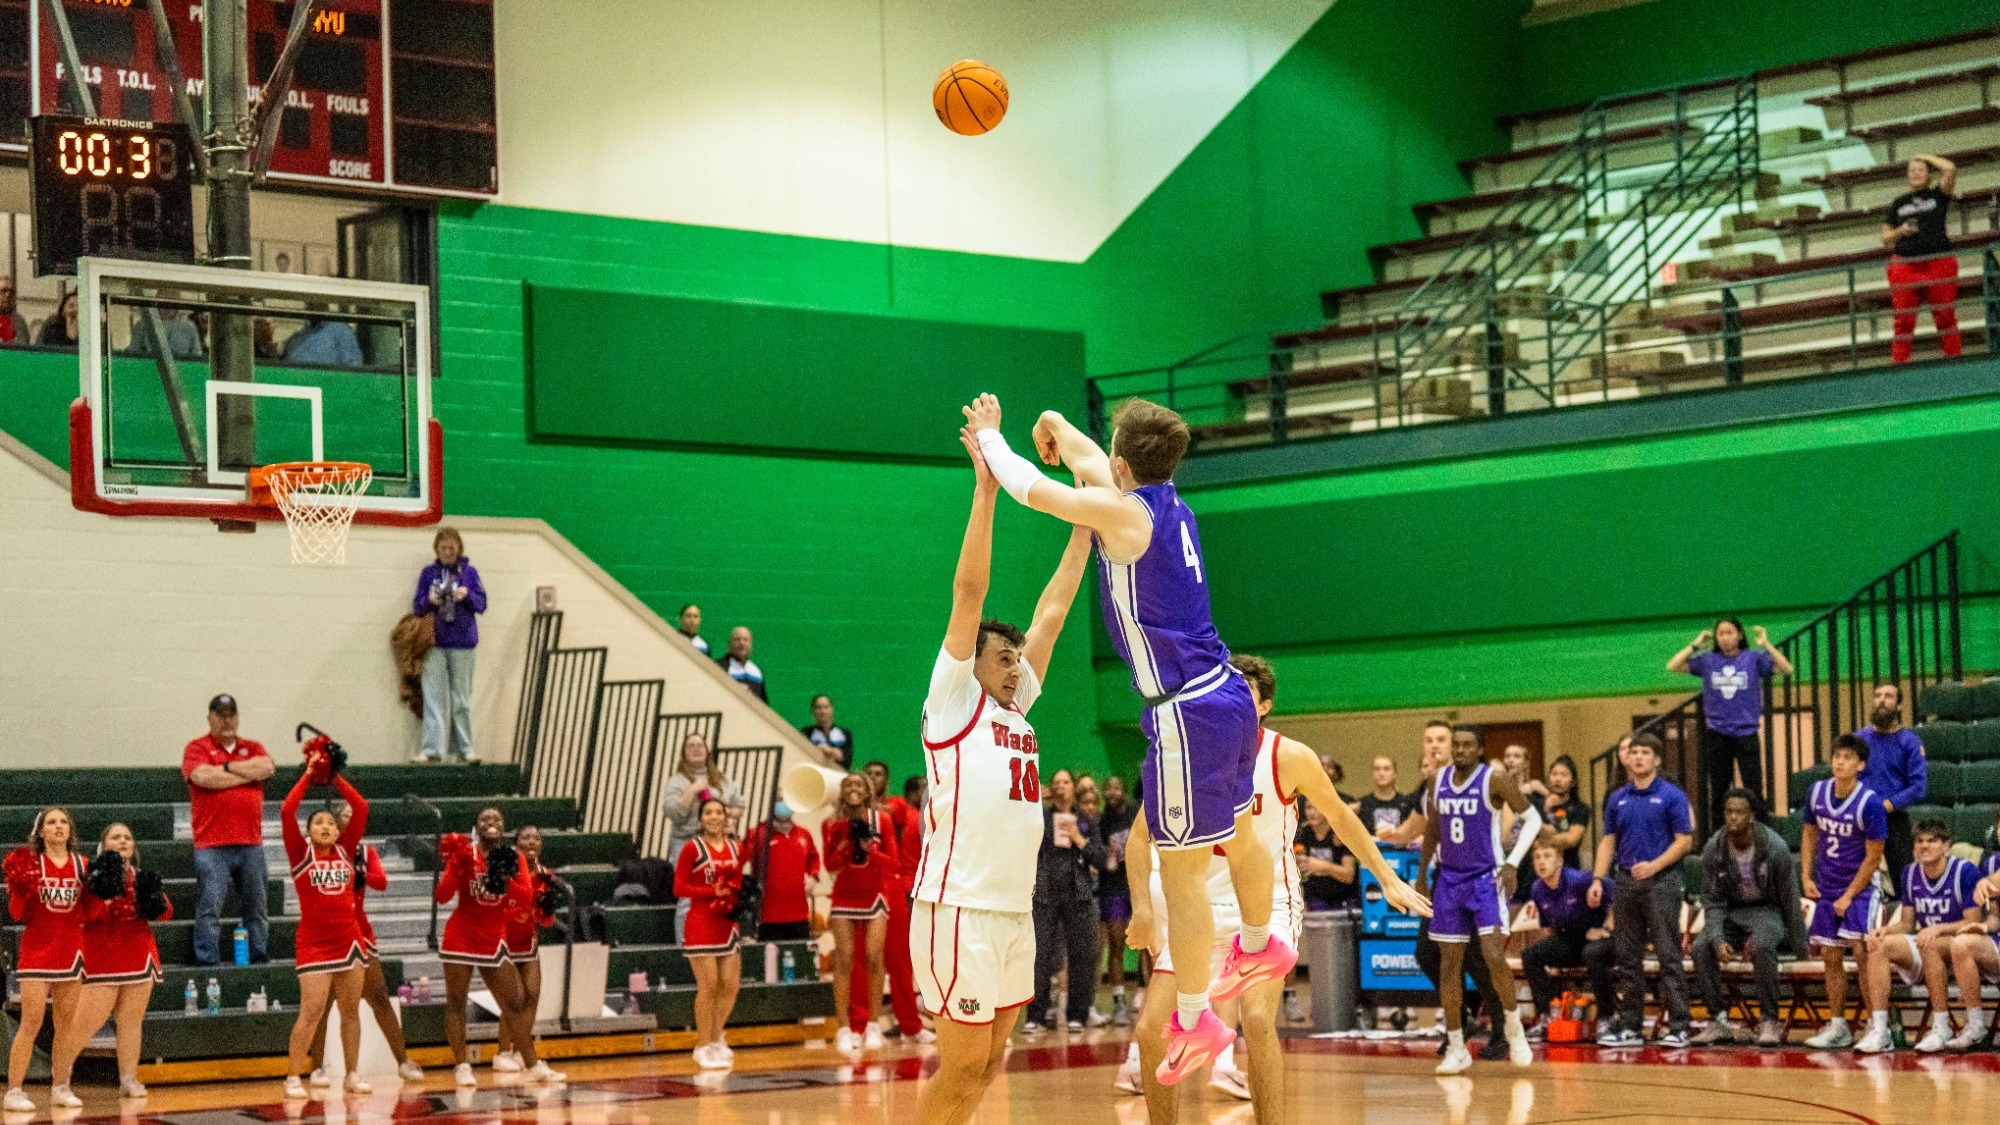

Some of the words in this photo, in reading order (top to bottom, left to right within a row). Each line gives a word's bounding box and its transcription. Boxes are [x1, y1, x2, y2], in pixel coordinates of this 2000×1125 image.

[56, 62, 102, 84] FLS
[326, 94, 369, 115] FOULS
[84, 117, 153, 129] DAKTRONICS
[60, 131, 151, 179] 00.3
[329, 159, 371, 179] SCORE
[1180, 520, 1203, 584] 4
[1009, 757, 1040, 803] 10
[1439, 798, 1478, 815] NYU
[1450, 817, 1465, 844] 8
[1816, 815, 1853, 837] NYU
[1826, 836, 1840, 859] 2
[310, 870, 350, 884] WASH
[1914, 897, 1951, 914] NYU
[958, 1001, 981, 1011] WASH
